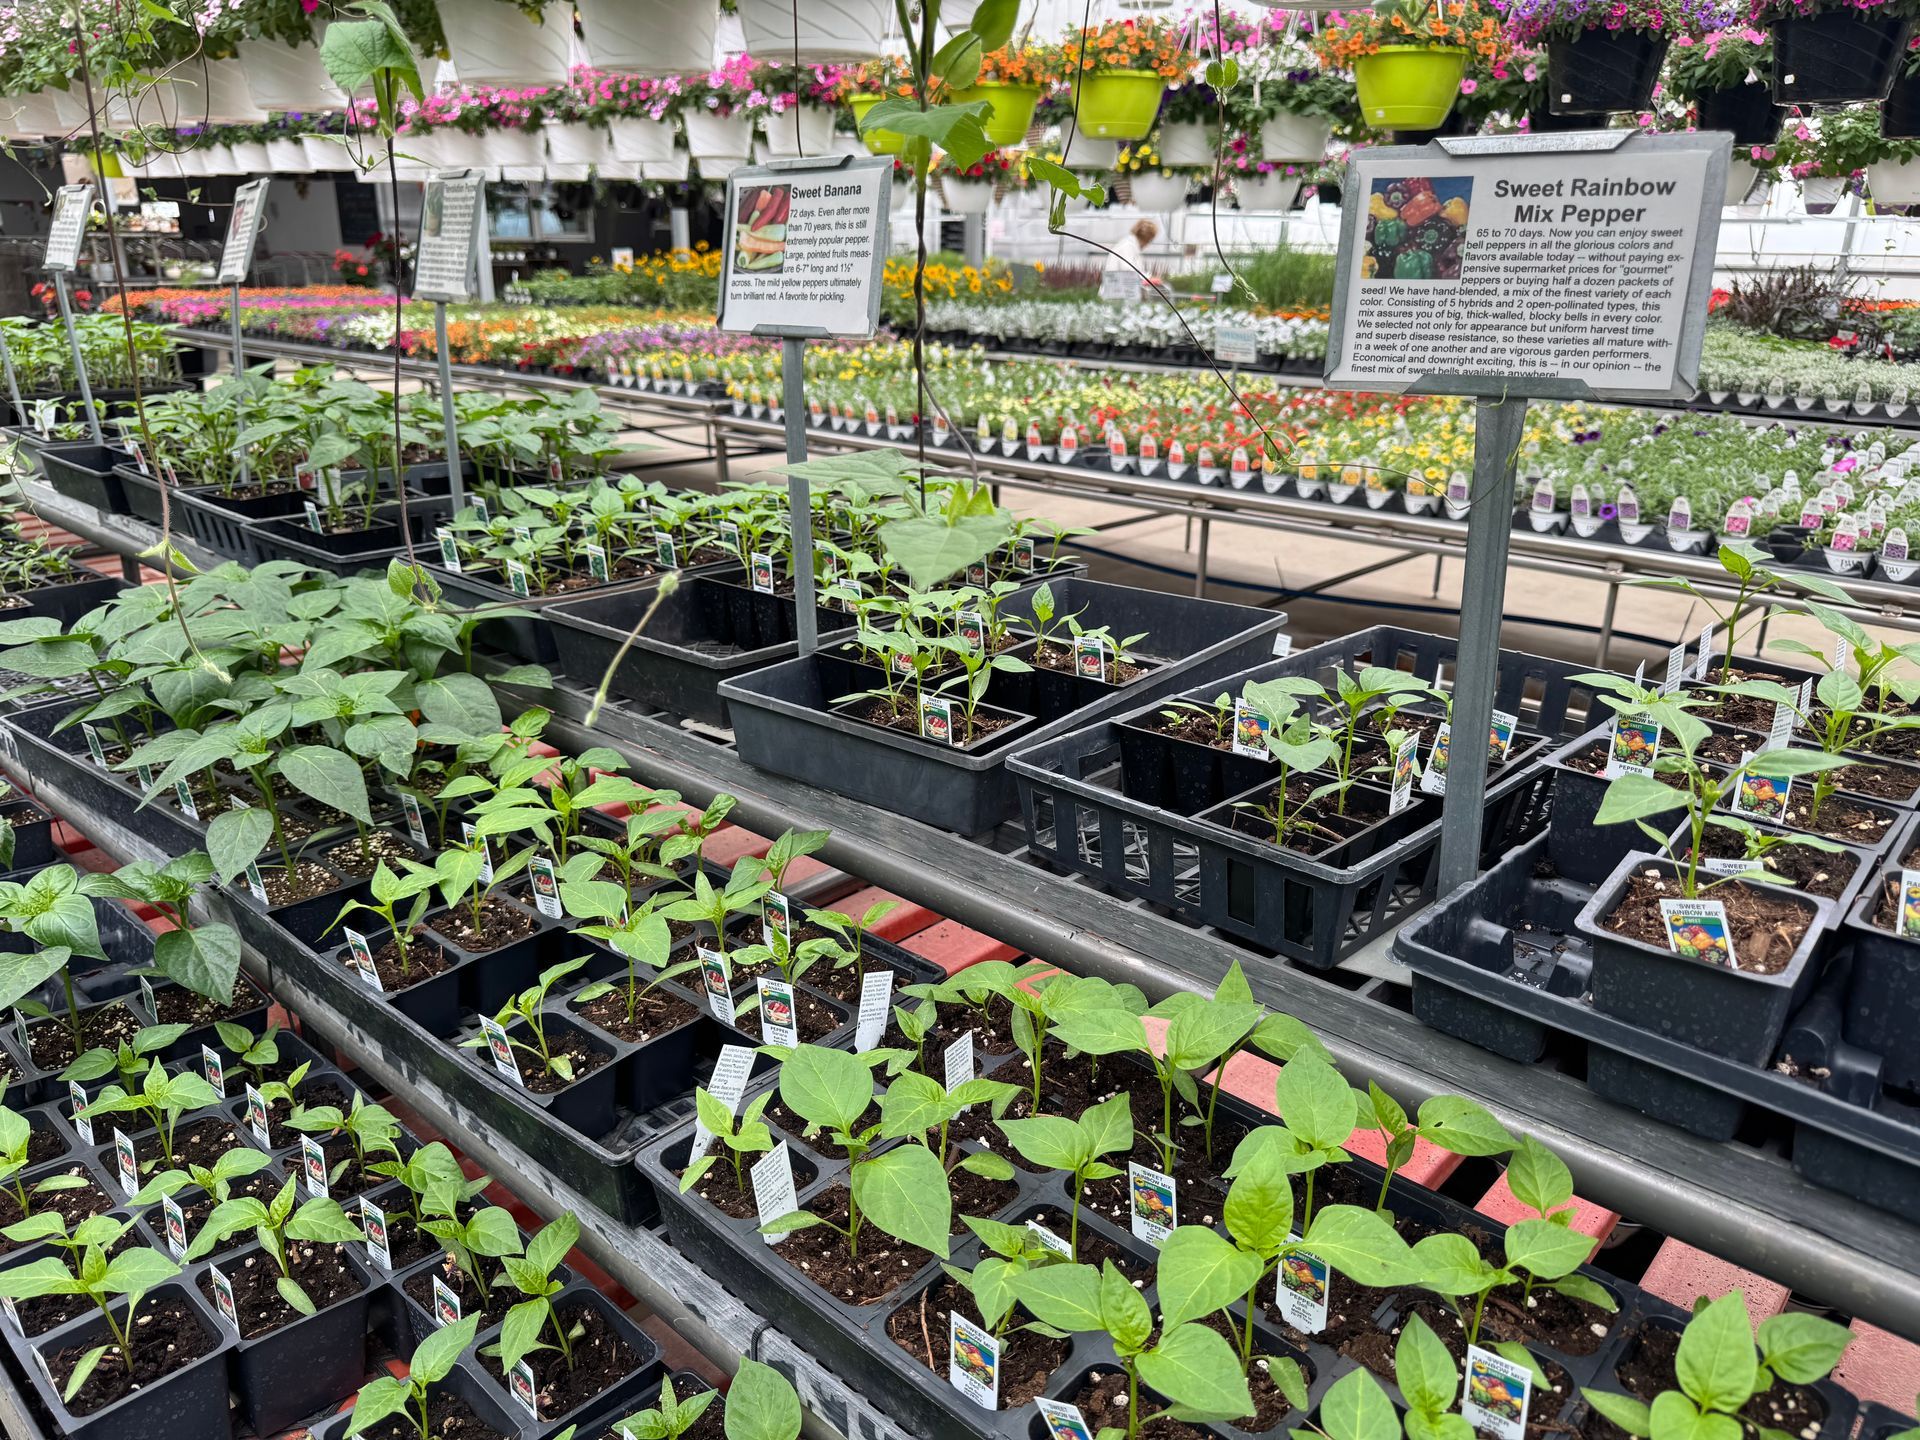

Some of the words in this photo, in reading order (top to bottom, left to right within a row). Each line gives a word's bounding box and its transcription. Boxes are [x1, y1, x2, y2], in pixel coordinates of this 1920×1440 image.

[791, 185, 822, 198] Sweet
[823, 184, 862, 196] Banana
[1494, 179, 1564, 197] Sweet
[1570, 177, 1677, 196] Rainbow
[1513, 204, 1554, 223] Mix
[1560, 204, 1647, 227] Pepper
[1476, 228, 1489, 238] 65
[1491, 228, 1502, 238] to
[1504, 228, 1517, 238] 70
[1518, 228, 1545, 240] days.
[1548, 228, 1573, 238] Now
[1574, 230, 1594, 240] you
[1618, 230, 1648, 240] enjoy
[1650, 228, 1683, 237] sweet
[1466, 240, 1484, 250] bell
[1485, 242, 1526, 252] peppers
[1528, 240, 1538, 250] in
[1540, 240, 1553, 250] all
[1554, 240, 1572, 250] the
[1573, 240, 1615, 252] glorious
[1617, 239, 1650, 249] colors
[1652, 239, 1674, 249] and
[1464, 251, 1497, 261] flavors
[1498, 251, 1544, 261] available
[1546, 252, 1575, 264] today
[1587, 252, 1626, 261] without
[1627, 252, 1664, 264] paying
[1462, 263, 1501, 275] pensive
[1502, 264, 1567, 275] supermarket
[1567, 264, 1600, 275] prices
[1602, 264, 1617, 274] for
[1460, 277, 1501, 286] peppers
[1502, 277, 1514, 285] or
[1515, 275, 1550, 287] buying
[1551, 275, 1572, 285] half
[1582, 276, 1615, 286] dozen
[1617, 276, 1660, 288] packets
[1662, 276, 1674, 286] of
[1360, 286, 1387, 295] seed!
[1389, 286, 1405, 295] We
[1406, 286, 1430, 296] have
[1432, 286, 1500, 297] hand-blended,
[1502, 289, 1510, 297] a
[1511, 287, 1530, 297] mix
[1532, 287, 1543, 297] of
[1544, 287, 1562, 297] the
[1563, 288, 1592, 298] finest
[1594, 288, 1630, 300] variety
[1631, 288, 1644, 298] of
[1644, 289, 1672, 299] each
[1359, 297, 1384, 306] color.
[1386, 297, 1436, 309] Consisting
[1437, 298, 1448, 307] of
[1449, 298, 1456, 308] 5
[1457, 298, 1493, 310] hybrids
[1495, 299, 1515, 308] and
[1516, 299, 1524, 309] 2
[1525, 300, 1605, 311] open-pollinated
[1606, 301, 1638, 313] types,
[1641, 301, 1661, 311] this
[1358, 308, 1375, 317] mix
[1376, 310, 1413, 318] assures
[1415, 311, 1433, 320] you
[1434, 309, 1445, 319] of
[1446, 309, 1463, 321] big,
[1466, 310, 1526, 321] thick-walled,
[1528, 311, 1562, 323] blocky
[1563, 311, 1588, 321] bells
[1590, 312, 1600, 322] in
[1602, 314, 1632, 324] every
[1634, 313, 1662, 323] color.
[1357, 319, 1373, 328] We
[1374, 319, 1414, 329] selected
[1415, 320, 1431, 330] not
[1432, 320, 1453, 332] only
[1454, 321, 1468, 330] for
[1469, 323, 1528, 333] appearance
[1530, 322, 1547, 332] but
[1548, 323, 1588, 333] uniform
[1589, 324, 1629, 334] harvest
[1631, 325, 1655, 335] time
[1355, 330, 1373, 340] and
[1374, 331, 1407, 342] superb
[1408, 331, 1446, 341] disease
[1447, 332, 1499, 344] resistance,
[1516, 334, 1545, 344] these
[1546, 335, 1590, 345] varieties
[1591, 336, 1605, 346] all
[1606, 337, 1644, 347] mature
[1646, 338, 1672, 347] with-
[1618, 764, 1643, 773] PEPPER
